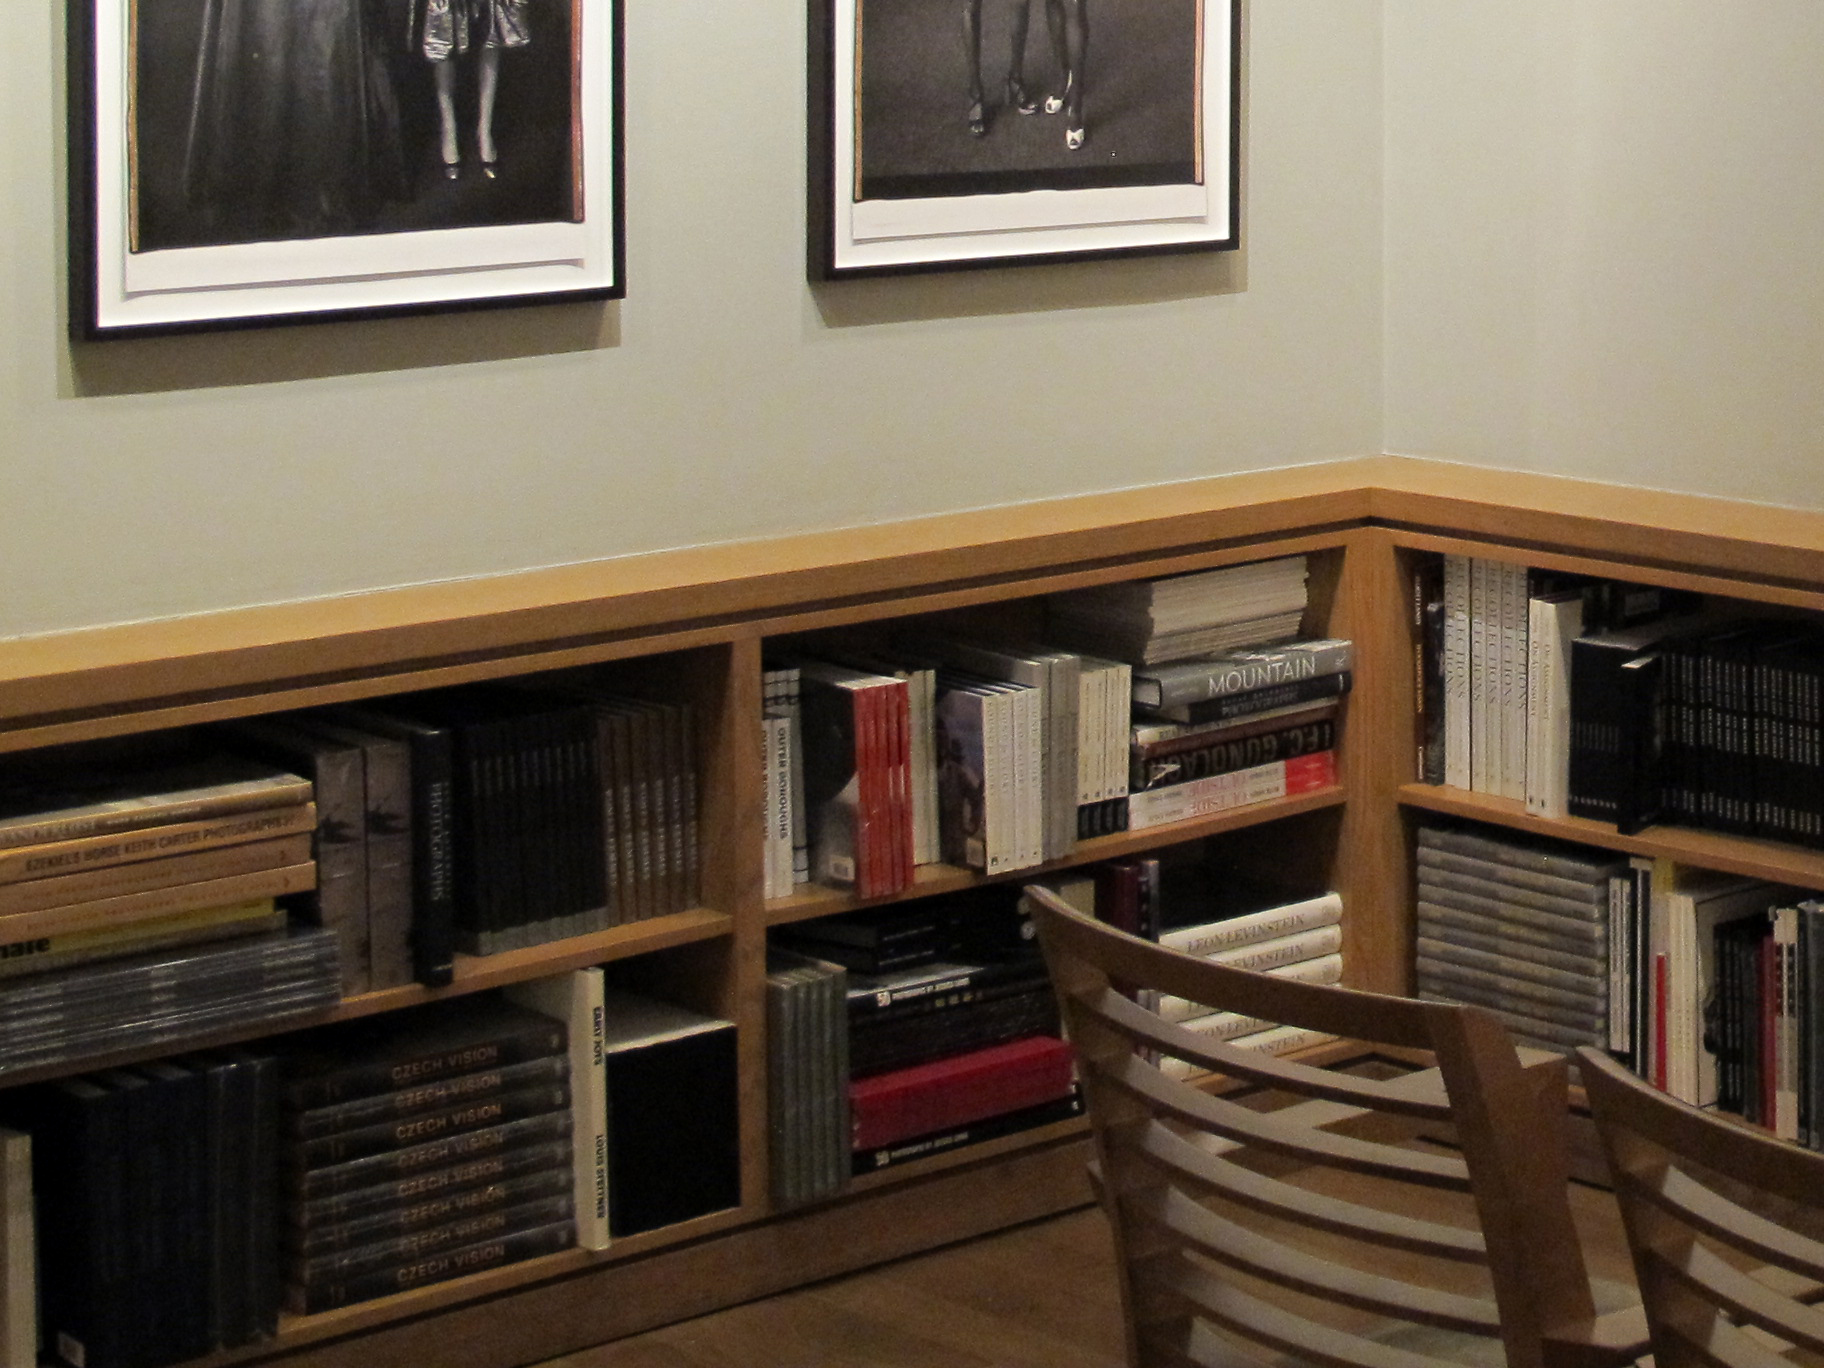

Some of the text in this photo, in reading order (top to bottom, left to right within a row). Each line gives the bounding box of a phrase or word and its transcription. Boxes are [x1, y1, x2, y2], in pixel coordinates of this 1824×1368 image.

[1208, 655, 1316, 696] MOUNTAIN
[777, 727, 787, 768] OUTER
[158, 830, 200, 849] CARTER
[392, 1045, 497, 1080] CZECH VISION
[395, 1103, 501, 1140] CZECH VISION
[397, 1245, 505, 1282] CZECH VISION
